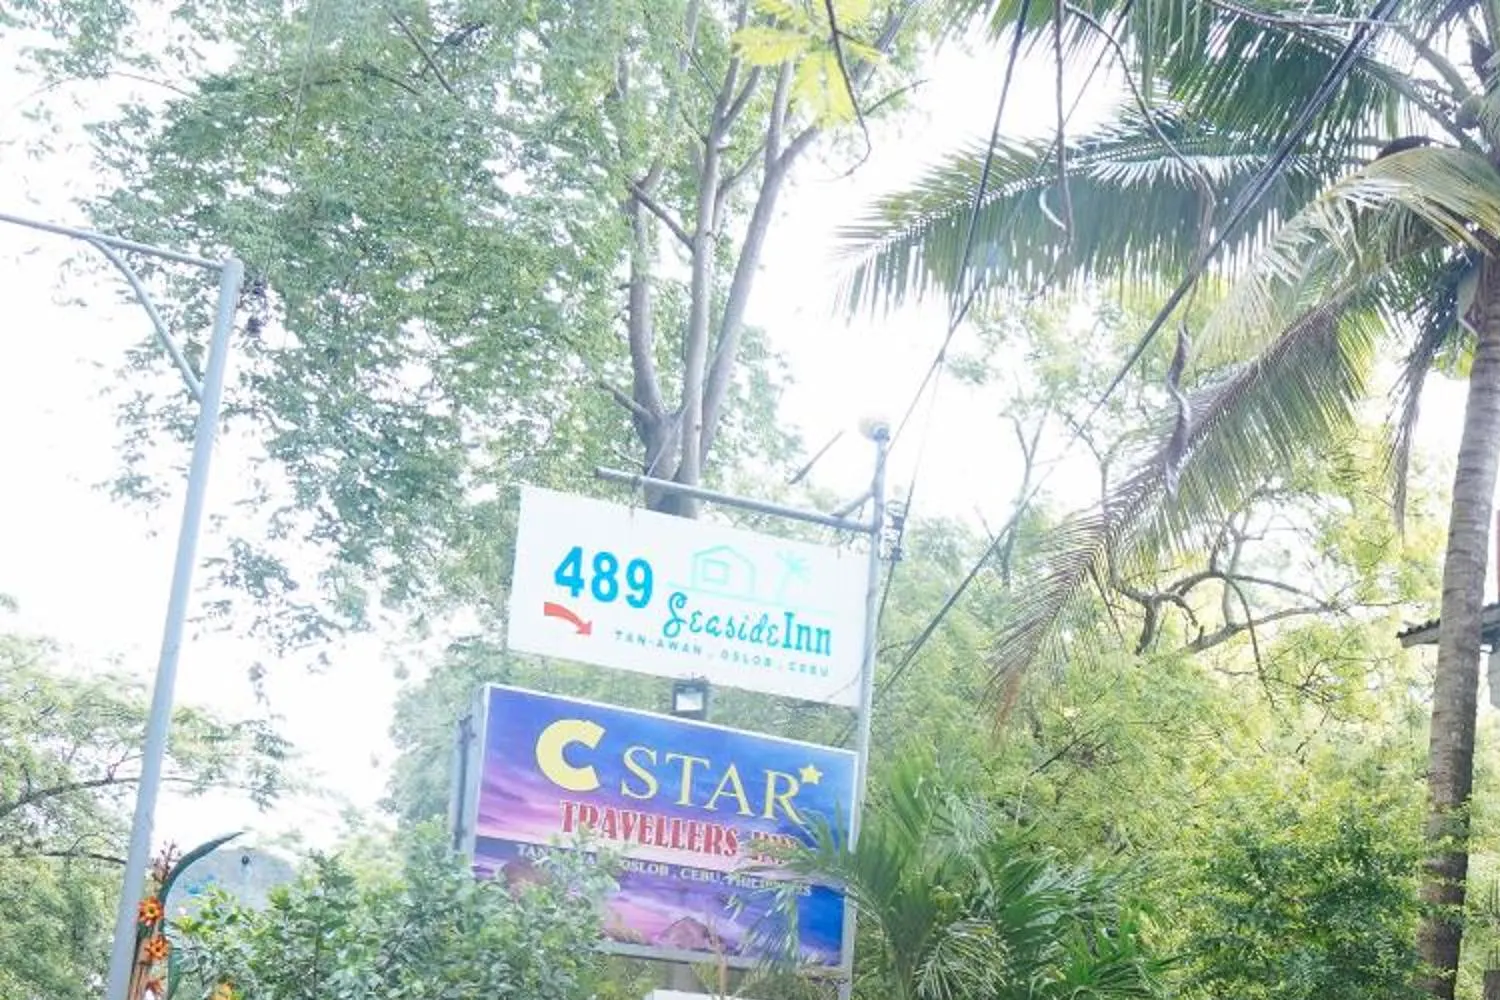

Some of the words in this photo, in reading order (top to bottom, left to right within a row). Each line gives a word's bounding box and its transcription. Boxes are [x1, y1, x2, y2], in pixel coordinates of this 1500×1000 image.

[554, 546, 653, 609] 489
[535, 718, 606, 792] C
[620, 745, 805, 825] STAR
[560, 800, 738, 857] TRAVELLERS
